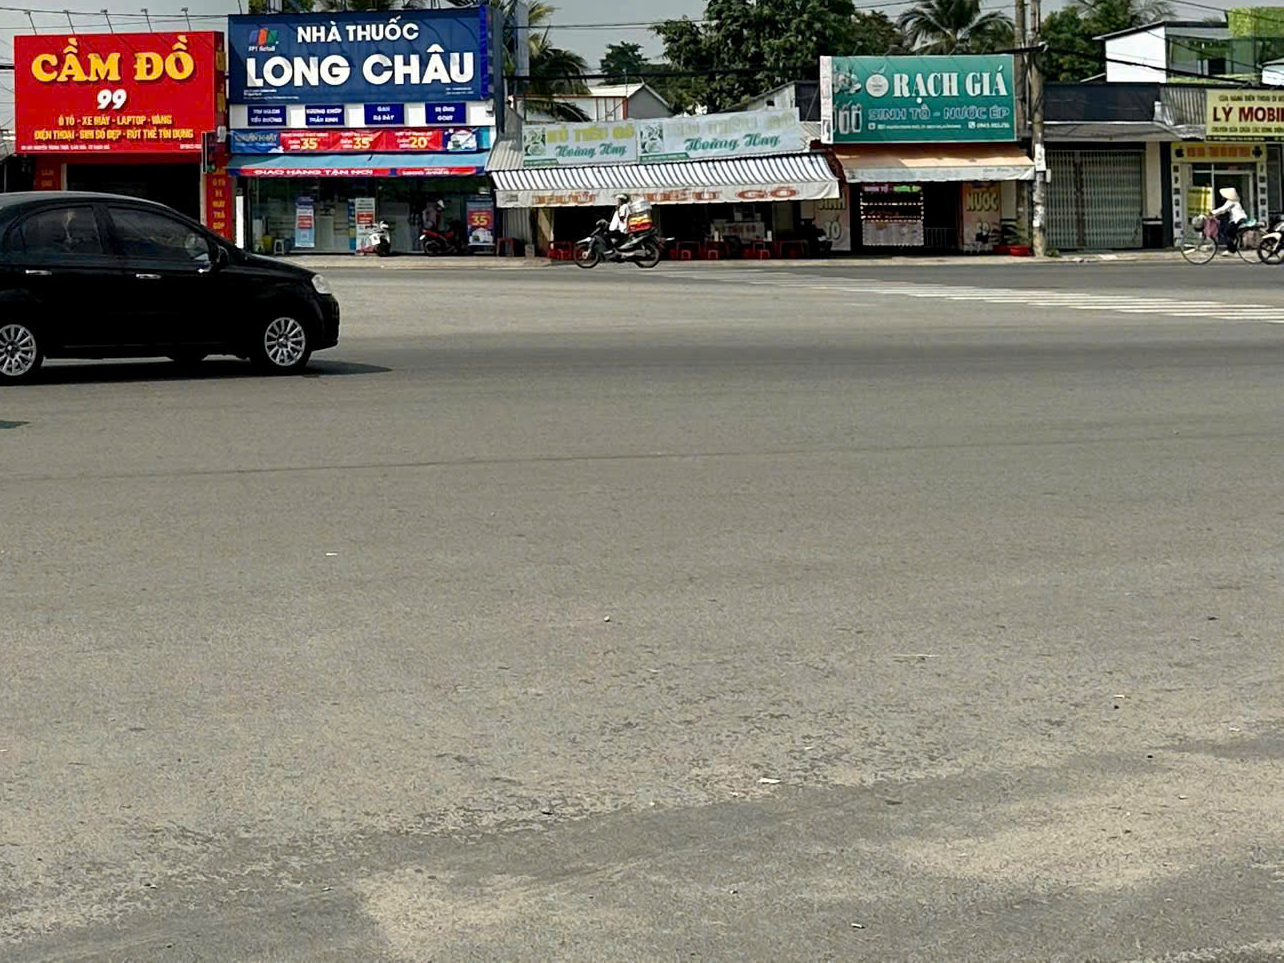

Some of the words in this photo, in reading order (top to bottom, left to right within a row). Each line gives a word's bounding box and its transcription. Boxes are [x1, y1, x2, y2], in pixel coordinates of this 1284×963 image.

[297, 21, 342, 43] NHÀ
[346, 15, 420, 42] THUỐC
[31, 37, 122, 83] CẦM
[133, 35, 195, 81] ĐỒ
[247, 54, 351, 87] LONG
[362, 44, 474, 86] CHÂU
[892, 72, 959, 104] RẠCH
[966, 65, 1008, 97] GIÁ
[97, 89, 127, 109] 99
[117, 115, 146, 125] LAPTOP
[868, 108, 907, 121] SINH
[1213, 103, 1233, 122] LÝ
